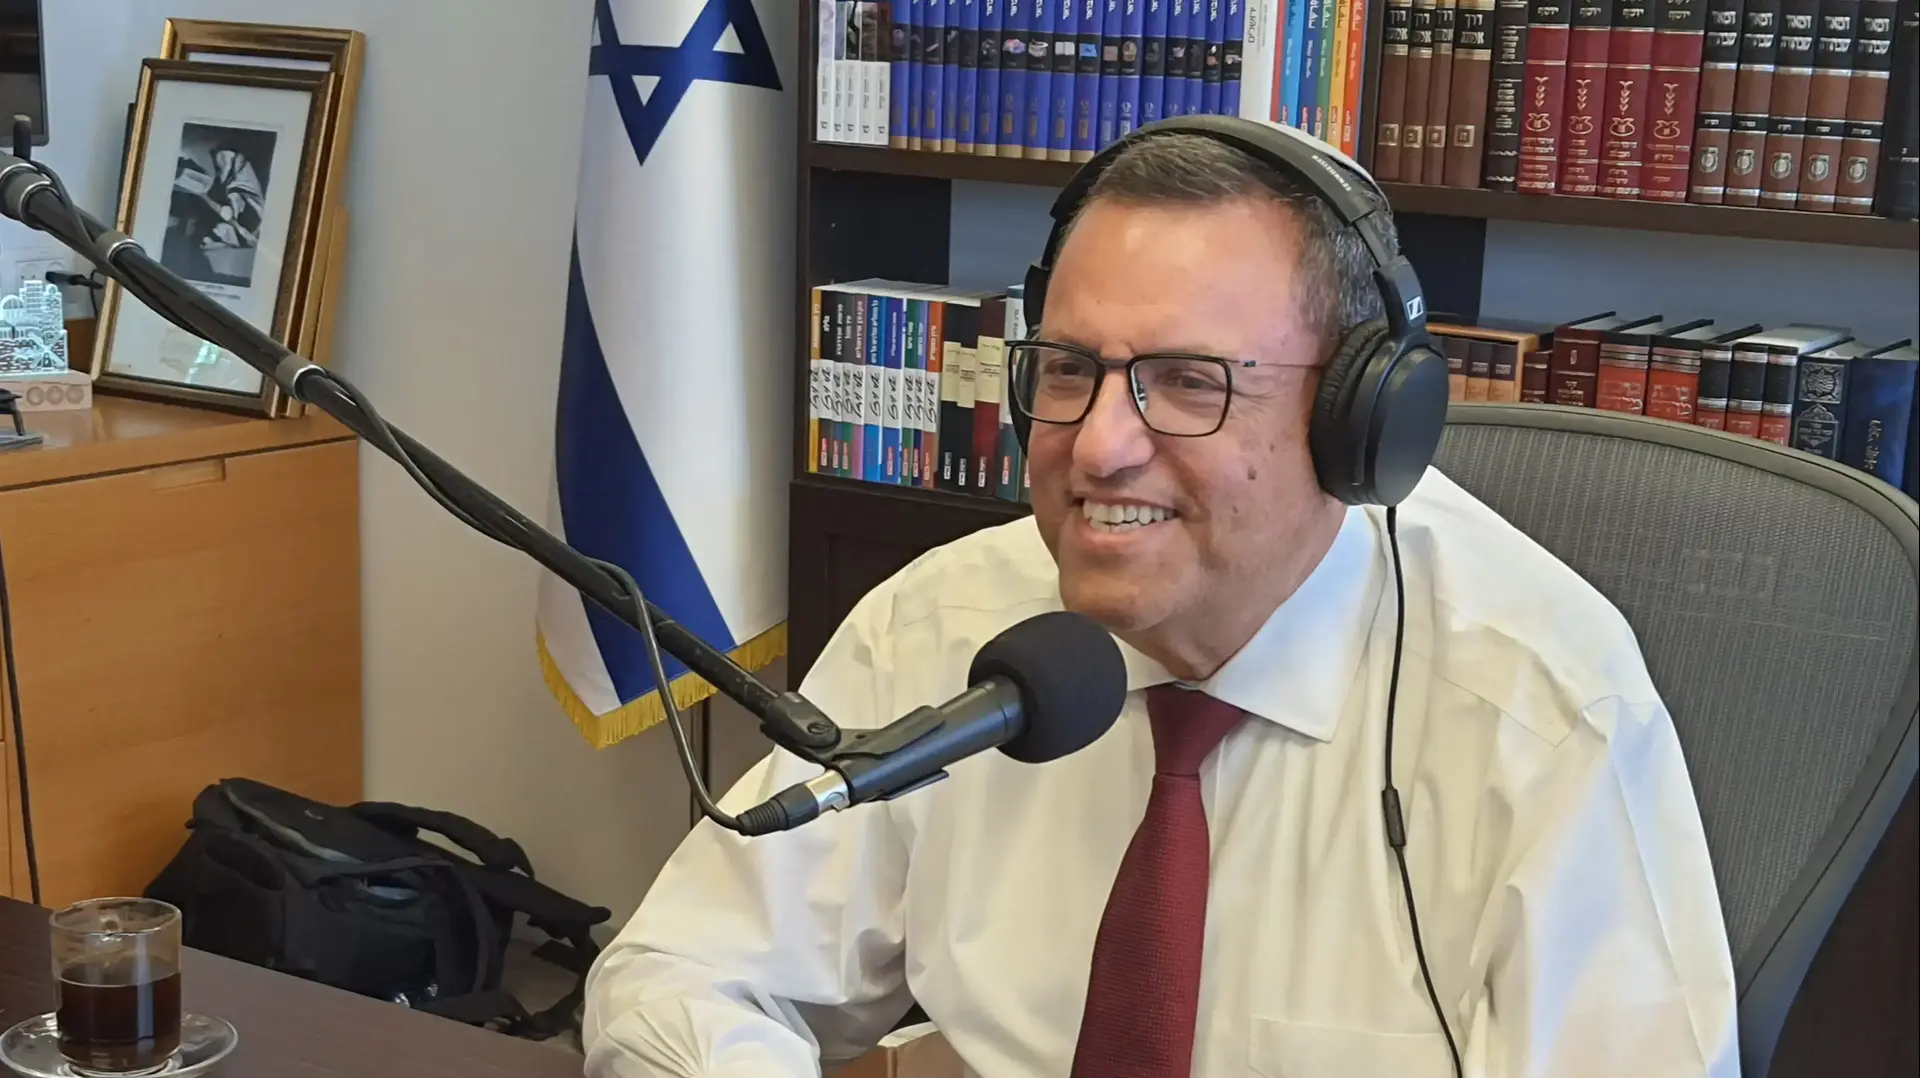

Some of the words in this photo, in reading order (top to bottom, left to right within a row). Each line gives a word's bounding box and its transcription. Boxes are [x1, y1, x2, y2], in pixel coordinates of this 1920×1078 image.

[1389, 10, 1407, 24] דרך
[1435, 10, 1453, 25] דרך
[1537, 6, 1559, 17] יוסף
[1579, 7, 1601, 19] יוסף
[1622, 8, 1645, 19] יוסף
[1668, 10, 1691, 21] יוסף
[1247, 7, 1256, 43] ירושלים
[1414, 13, 1431, 27] דרך
[1464, 13, 1483, 29] דרך
